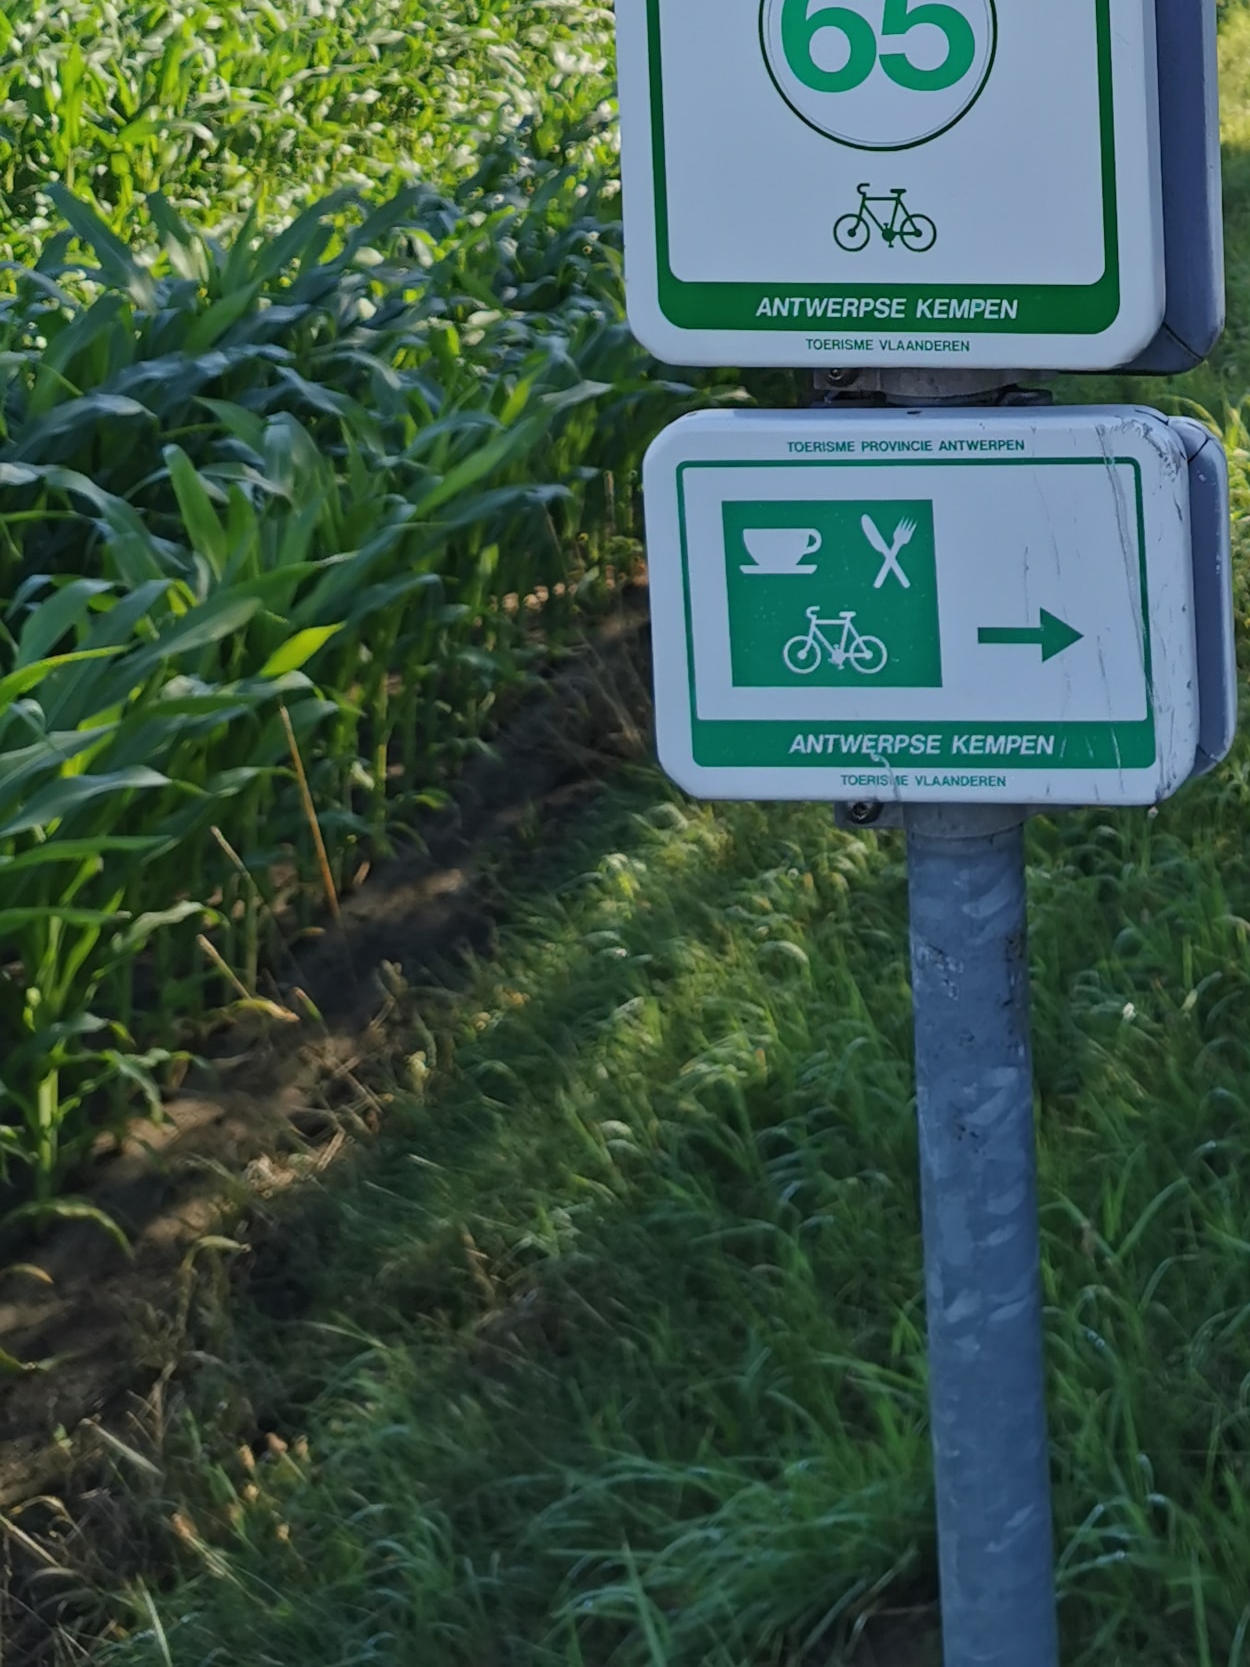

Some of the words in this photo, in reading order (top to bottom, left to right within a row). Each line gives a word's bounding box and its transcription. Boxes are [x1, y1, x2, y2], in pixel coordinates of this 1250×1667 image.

[755, 297, 907, 319] ANTWERPSE
[915, 298, 1019, 320] KEMPEN
[805, 338, 874, 351] TOERISME
[879, 338, 970, 352] VLAANDEREN
[787, 441, 856, 453] TOERISME
[860, 440, 934, 453] PROVINCIE
[938, 438, 1025, 452] ANTWERPEN
[788, 733, 942, 754] ANTWERPSE
[950, 734, 1055, 755] KEMPEN
[914, 774, 1007, 788] VLAANDEREN
